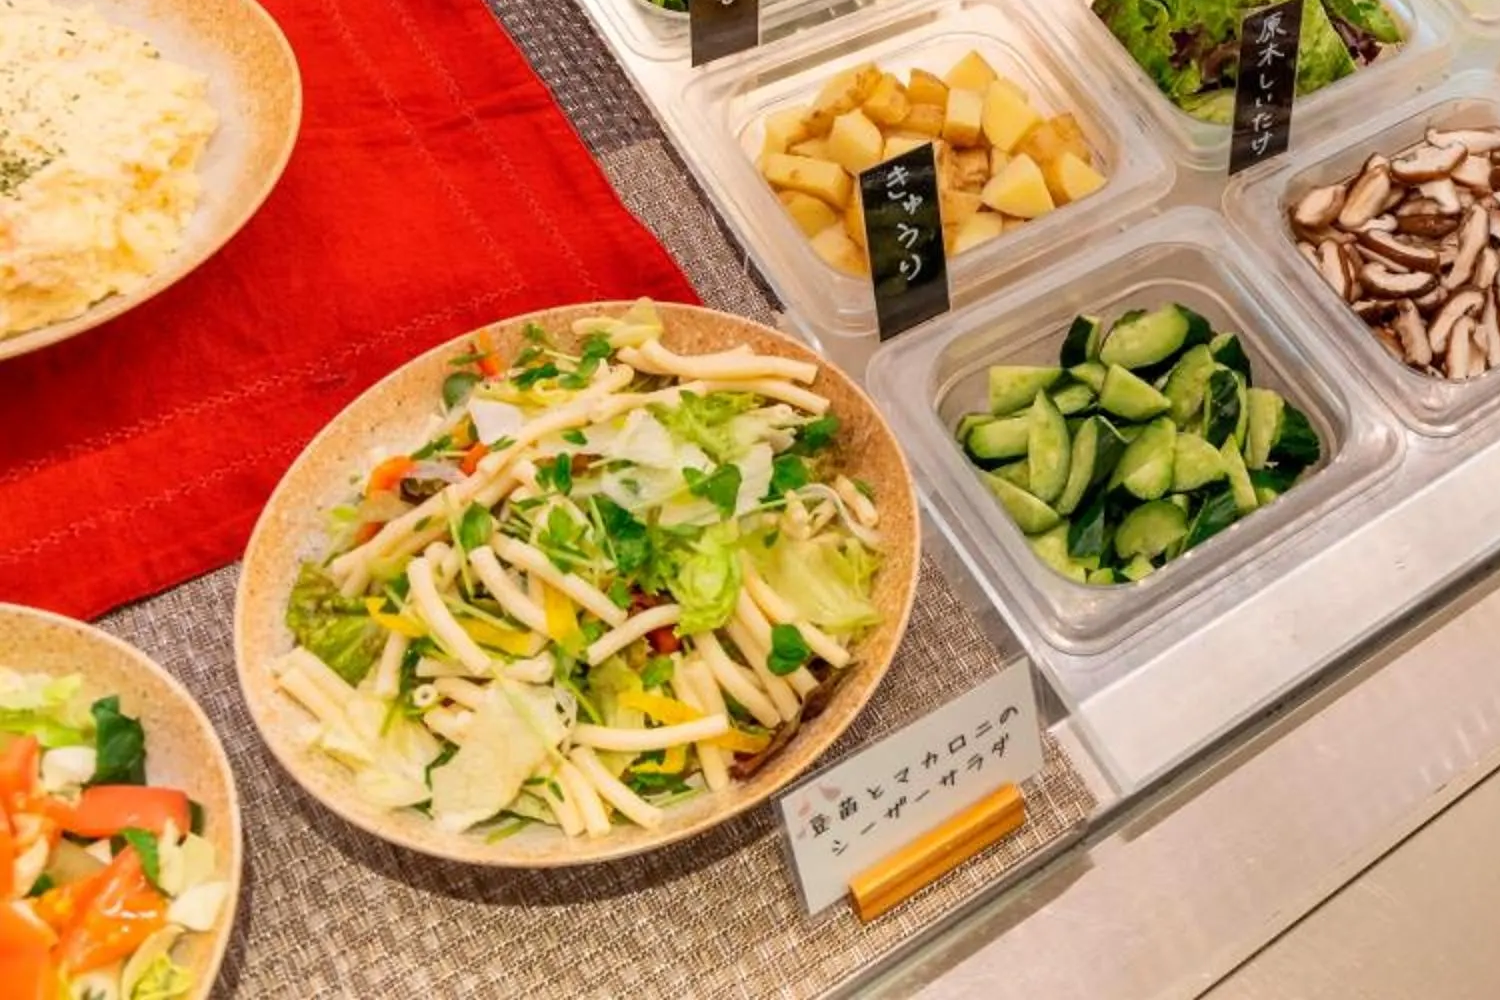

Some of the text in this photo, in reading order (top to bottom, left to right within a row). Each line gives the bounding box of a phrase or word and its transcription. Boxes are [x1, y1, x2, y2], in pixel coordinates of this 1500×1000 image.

[1251, 10, 1287, 156] 原木しいたけ
[885, 164, 924, 281] きゅうり
[808, 705, 1019, 838] 豆苗とマカロニの
[830, 732, 1011, 857] シーザーサラダ
